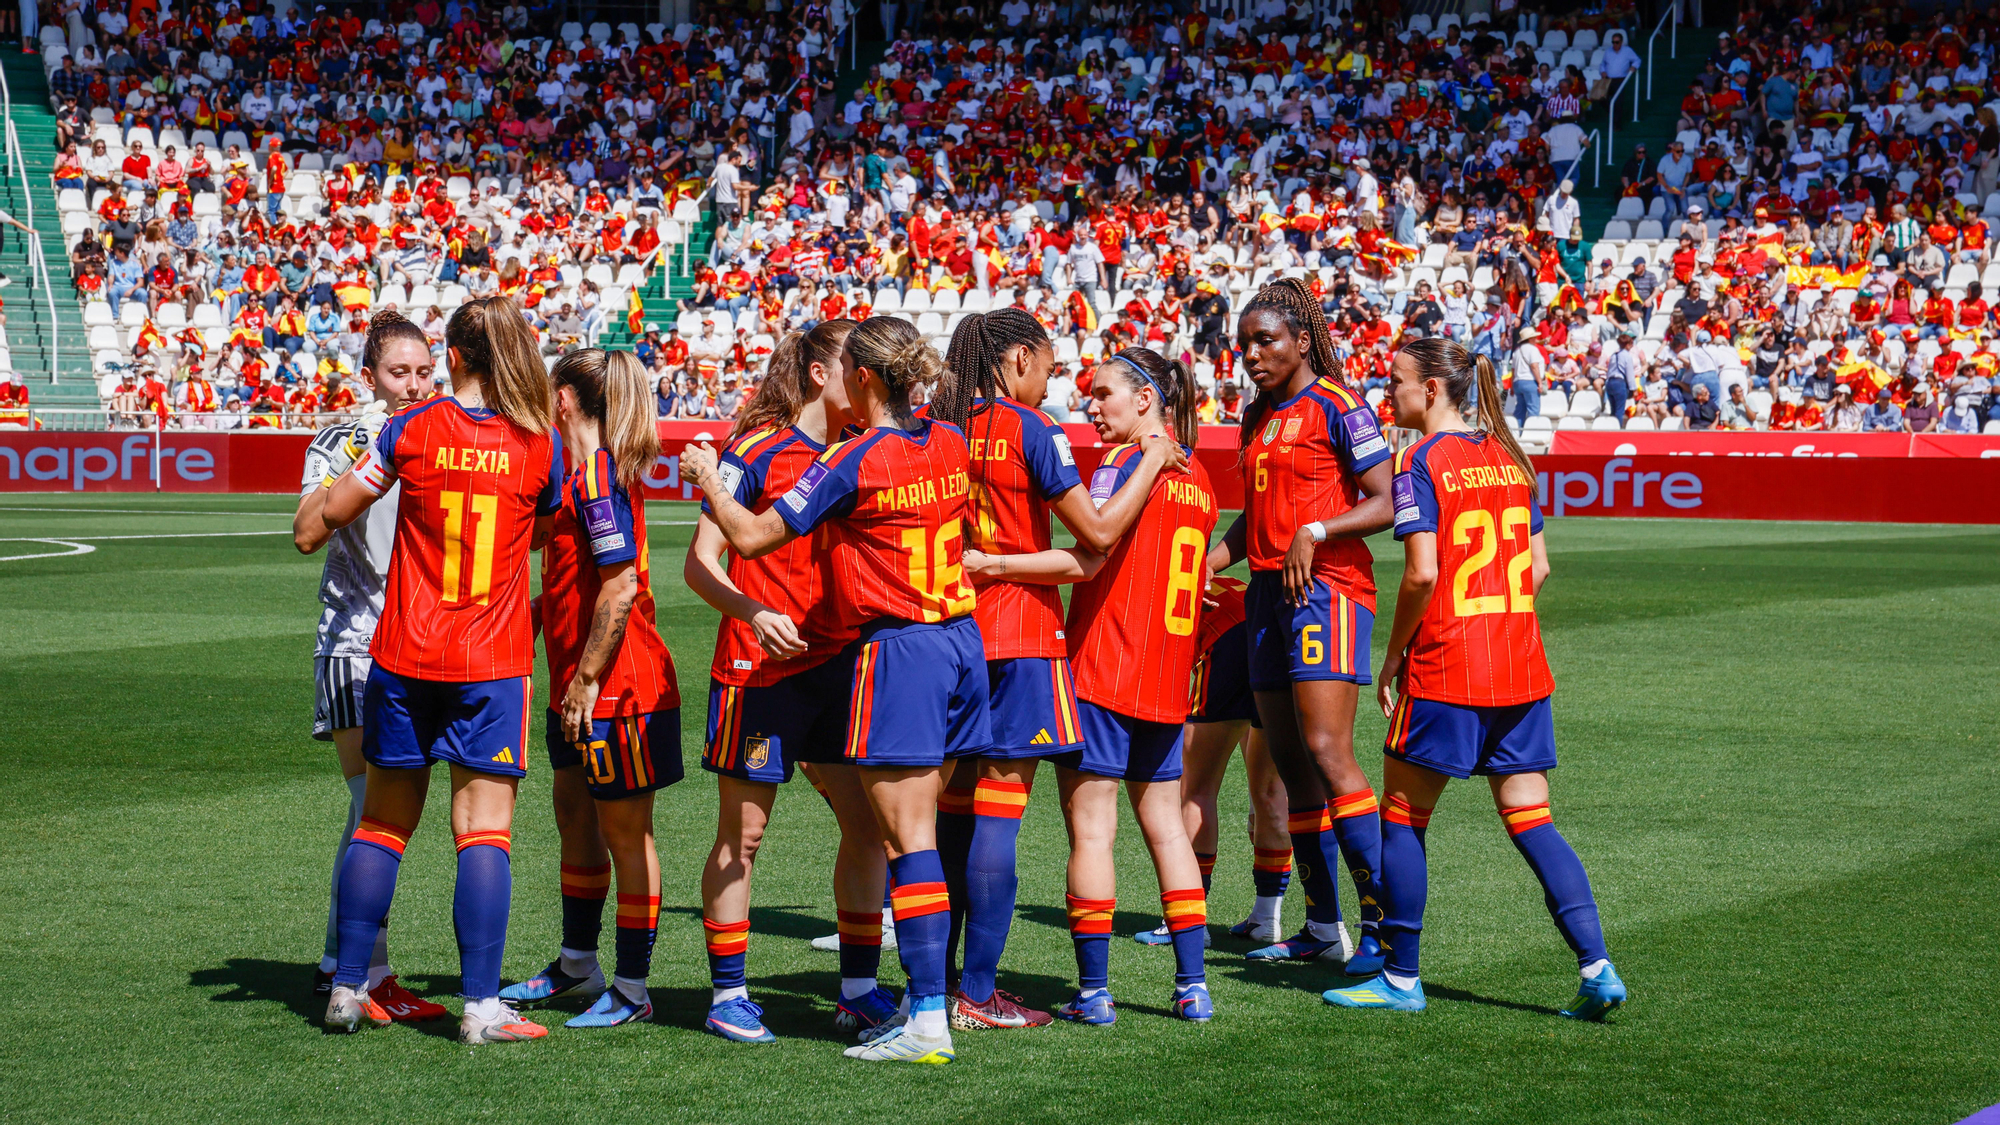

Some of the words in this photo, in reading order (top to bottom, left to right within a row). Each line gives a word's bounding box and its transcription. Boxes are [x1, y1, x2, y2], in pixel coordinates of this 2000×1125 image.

[434, 446, 510, 475] ALEXIA
[1255, 452, 1269, 492] 6
[876, 475, 936, 512] MARÍA
[1167, 479, 1211, 514] MARINA
[1442, 471, 1461, 493] C.
[1538, 458, 1703, 516] pfre
[439, 490, 498, 606] 11
[1452, 505, 1534, 617] 22
[901, 518, 976, 623] 16
[1163, 526, 1206, 637] 8
[1301, 624, 1324, 665] 6
